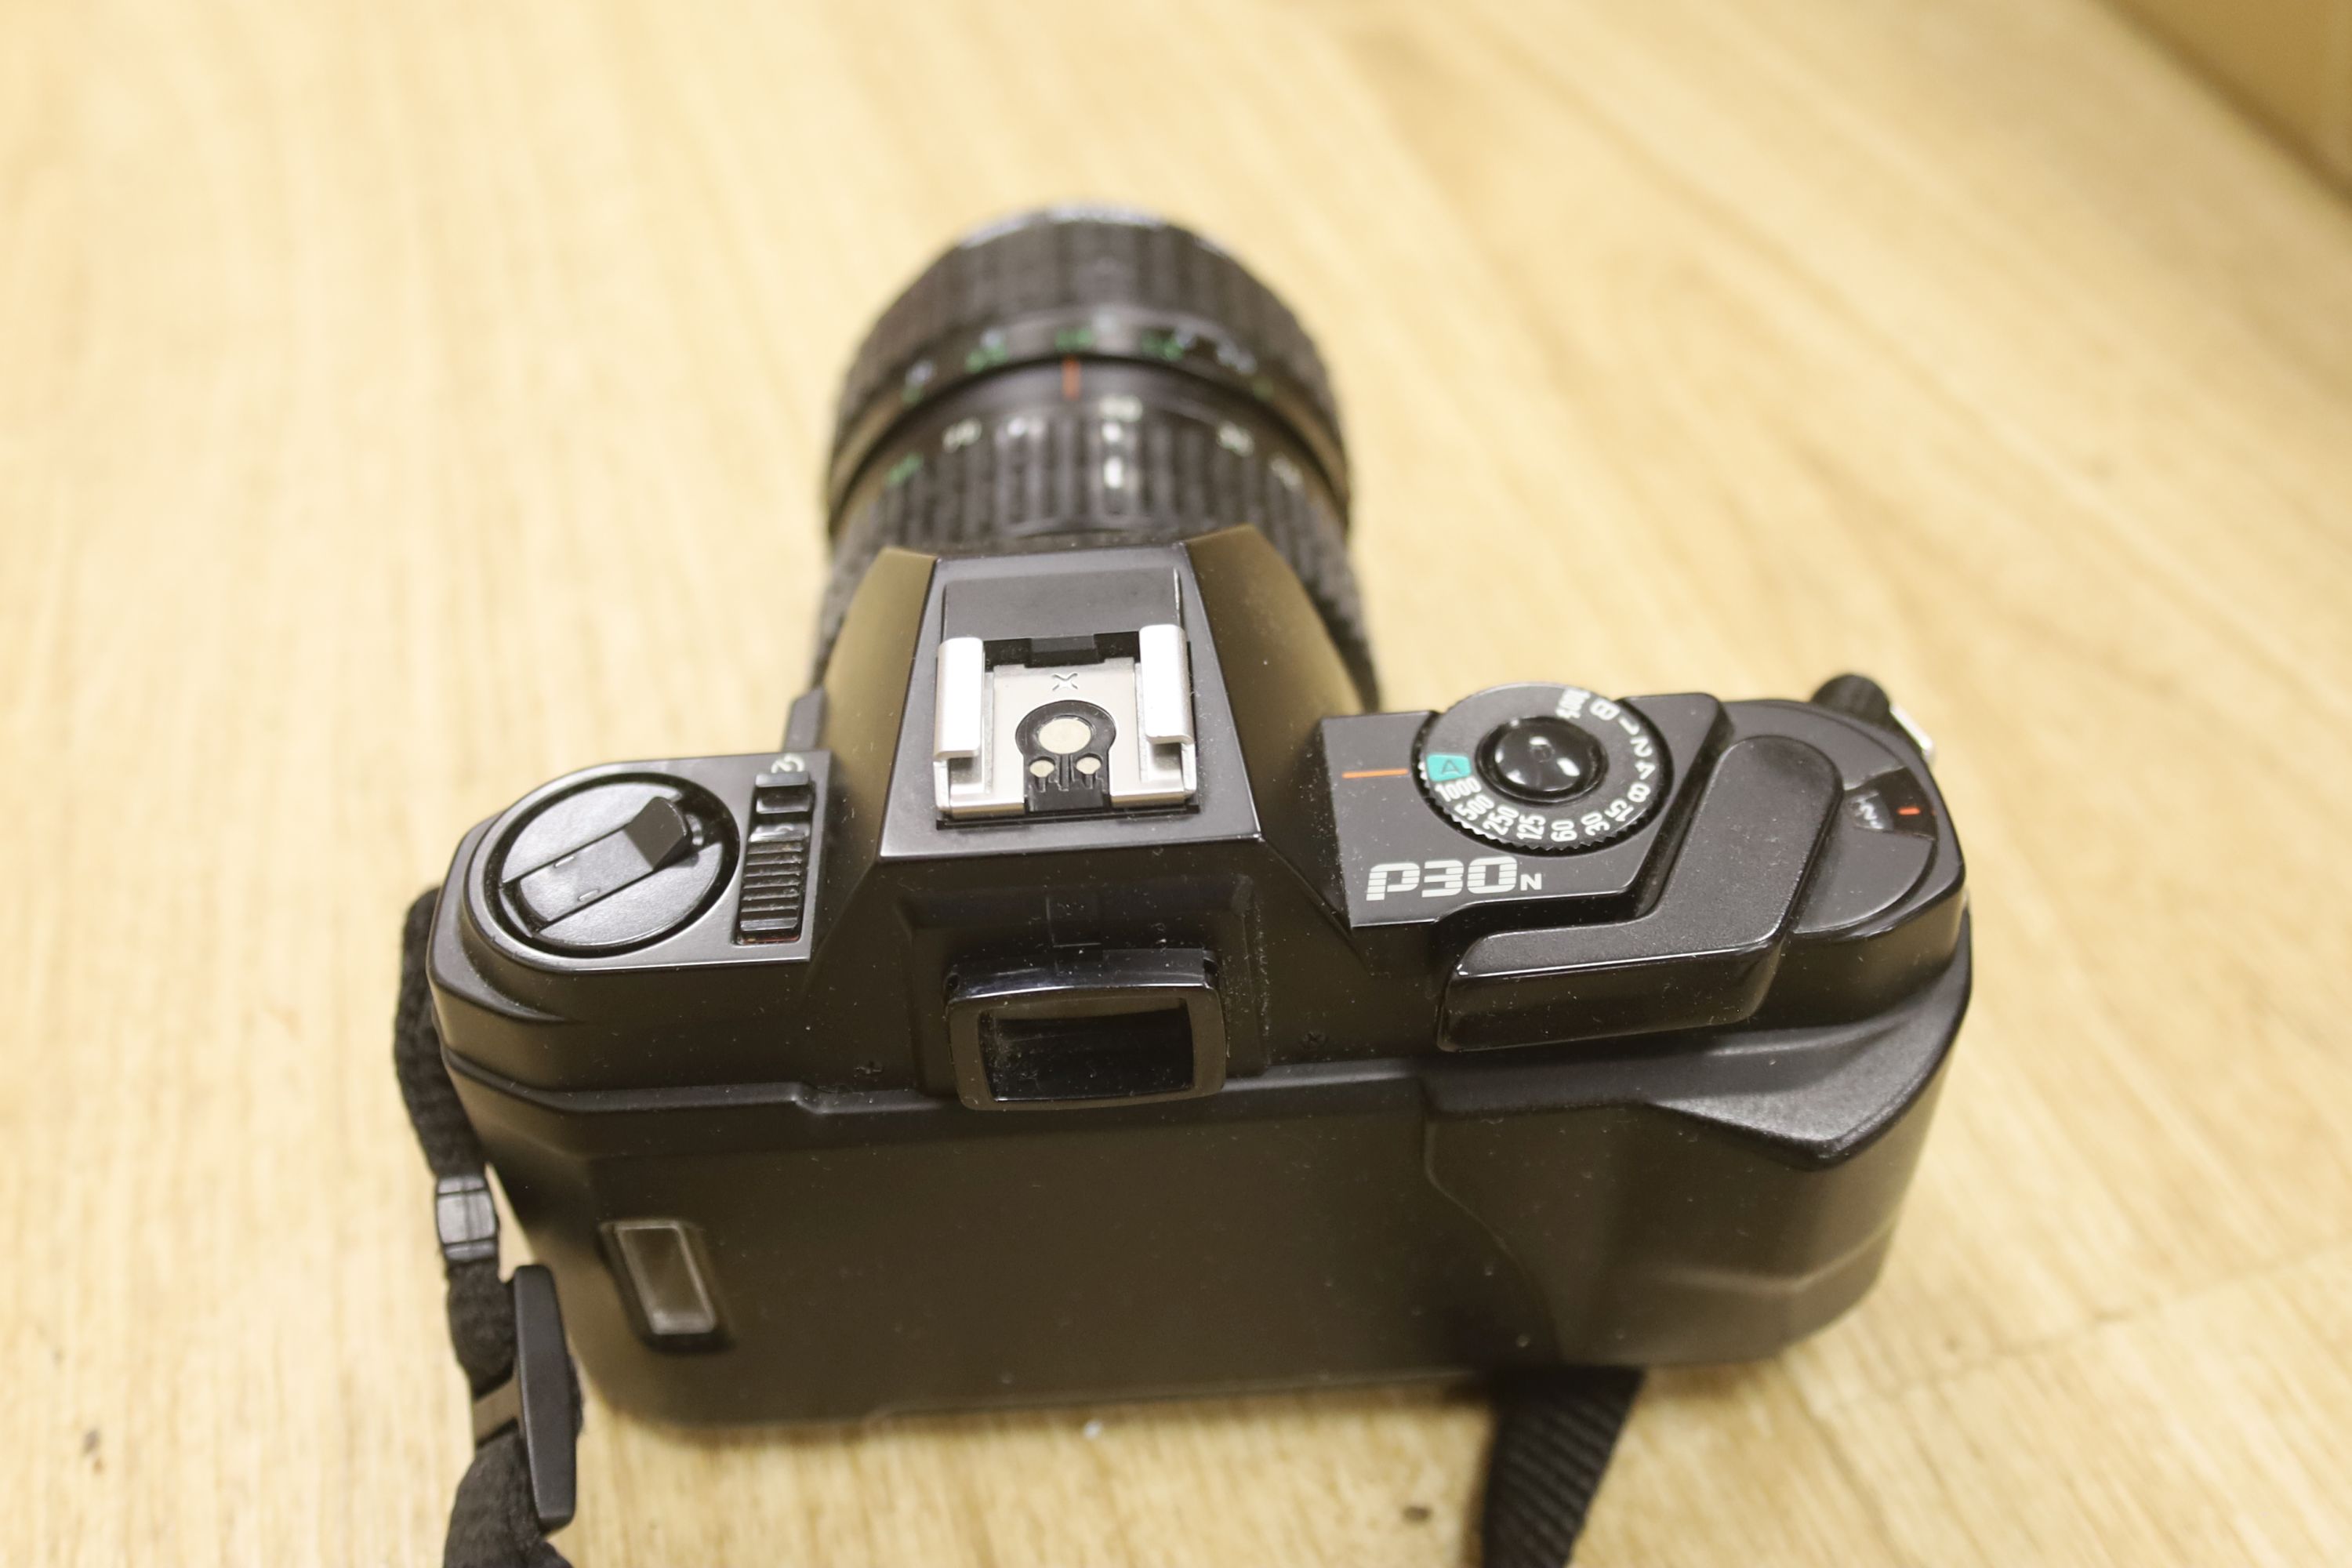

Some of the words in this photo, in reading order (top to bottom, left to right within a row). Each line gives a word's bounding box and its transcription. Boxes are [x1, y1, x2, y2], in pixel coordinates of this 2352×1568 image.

[1051, 671, 1078, 692] X
[1619, 717, 1639, 735] 1
[1629, 735, 1653, 757] 2
[1441, 758, 1463, 775] A
[1635, 760, 1656, 780] 4
[1433, 775, 1483, 803] 1000
[1627, 782, 1651, 803] 8
[1454, 793, 1495, 821] 500
[1604, 798, 1635, 822] 15
[1482, 804, 1520, 836] 250
[1515, 813, 1547, 840] 125
[1550, 818, 1578, 843] 60
[1580, 811, 1611, 837] 30
